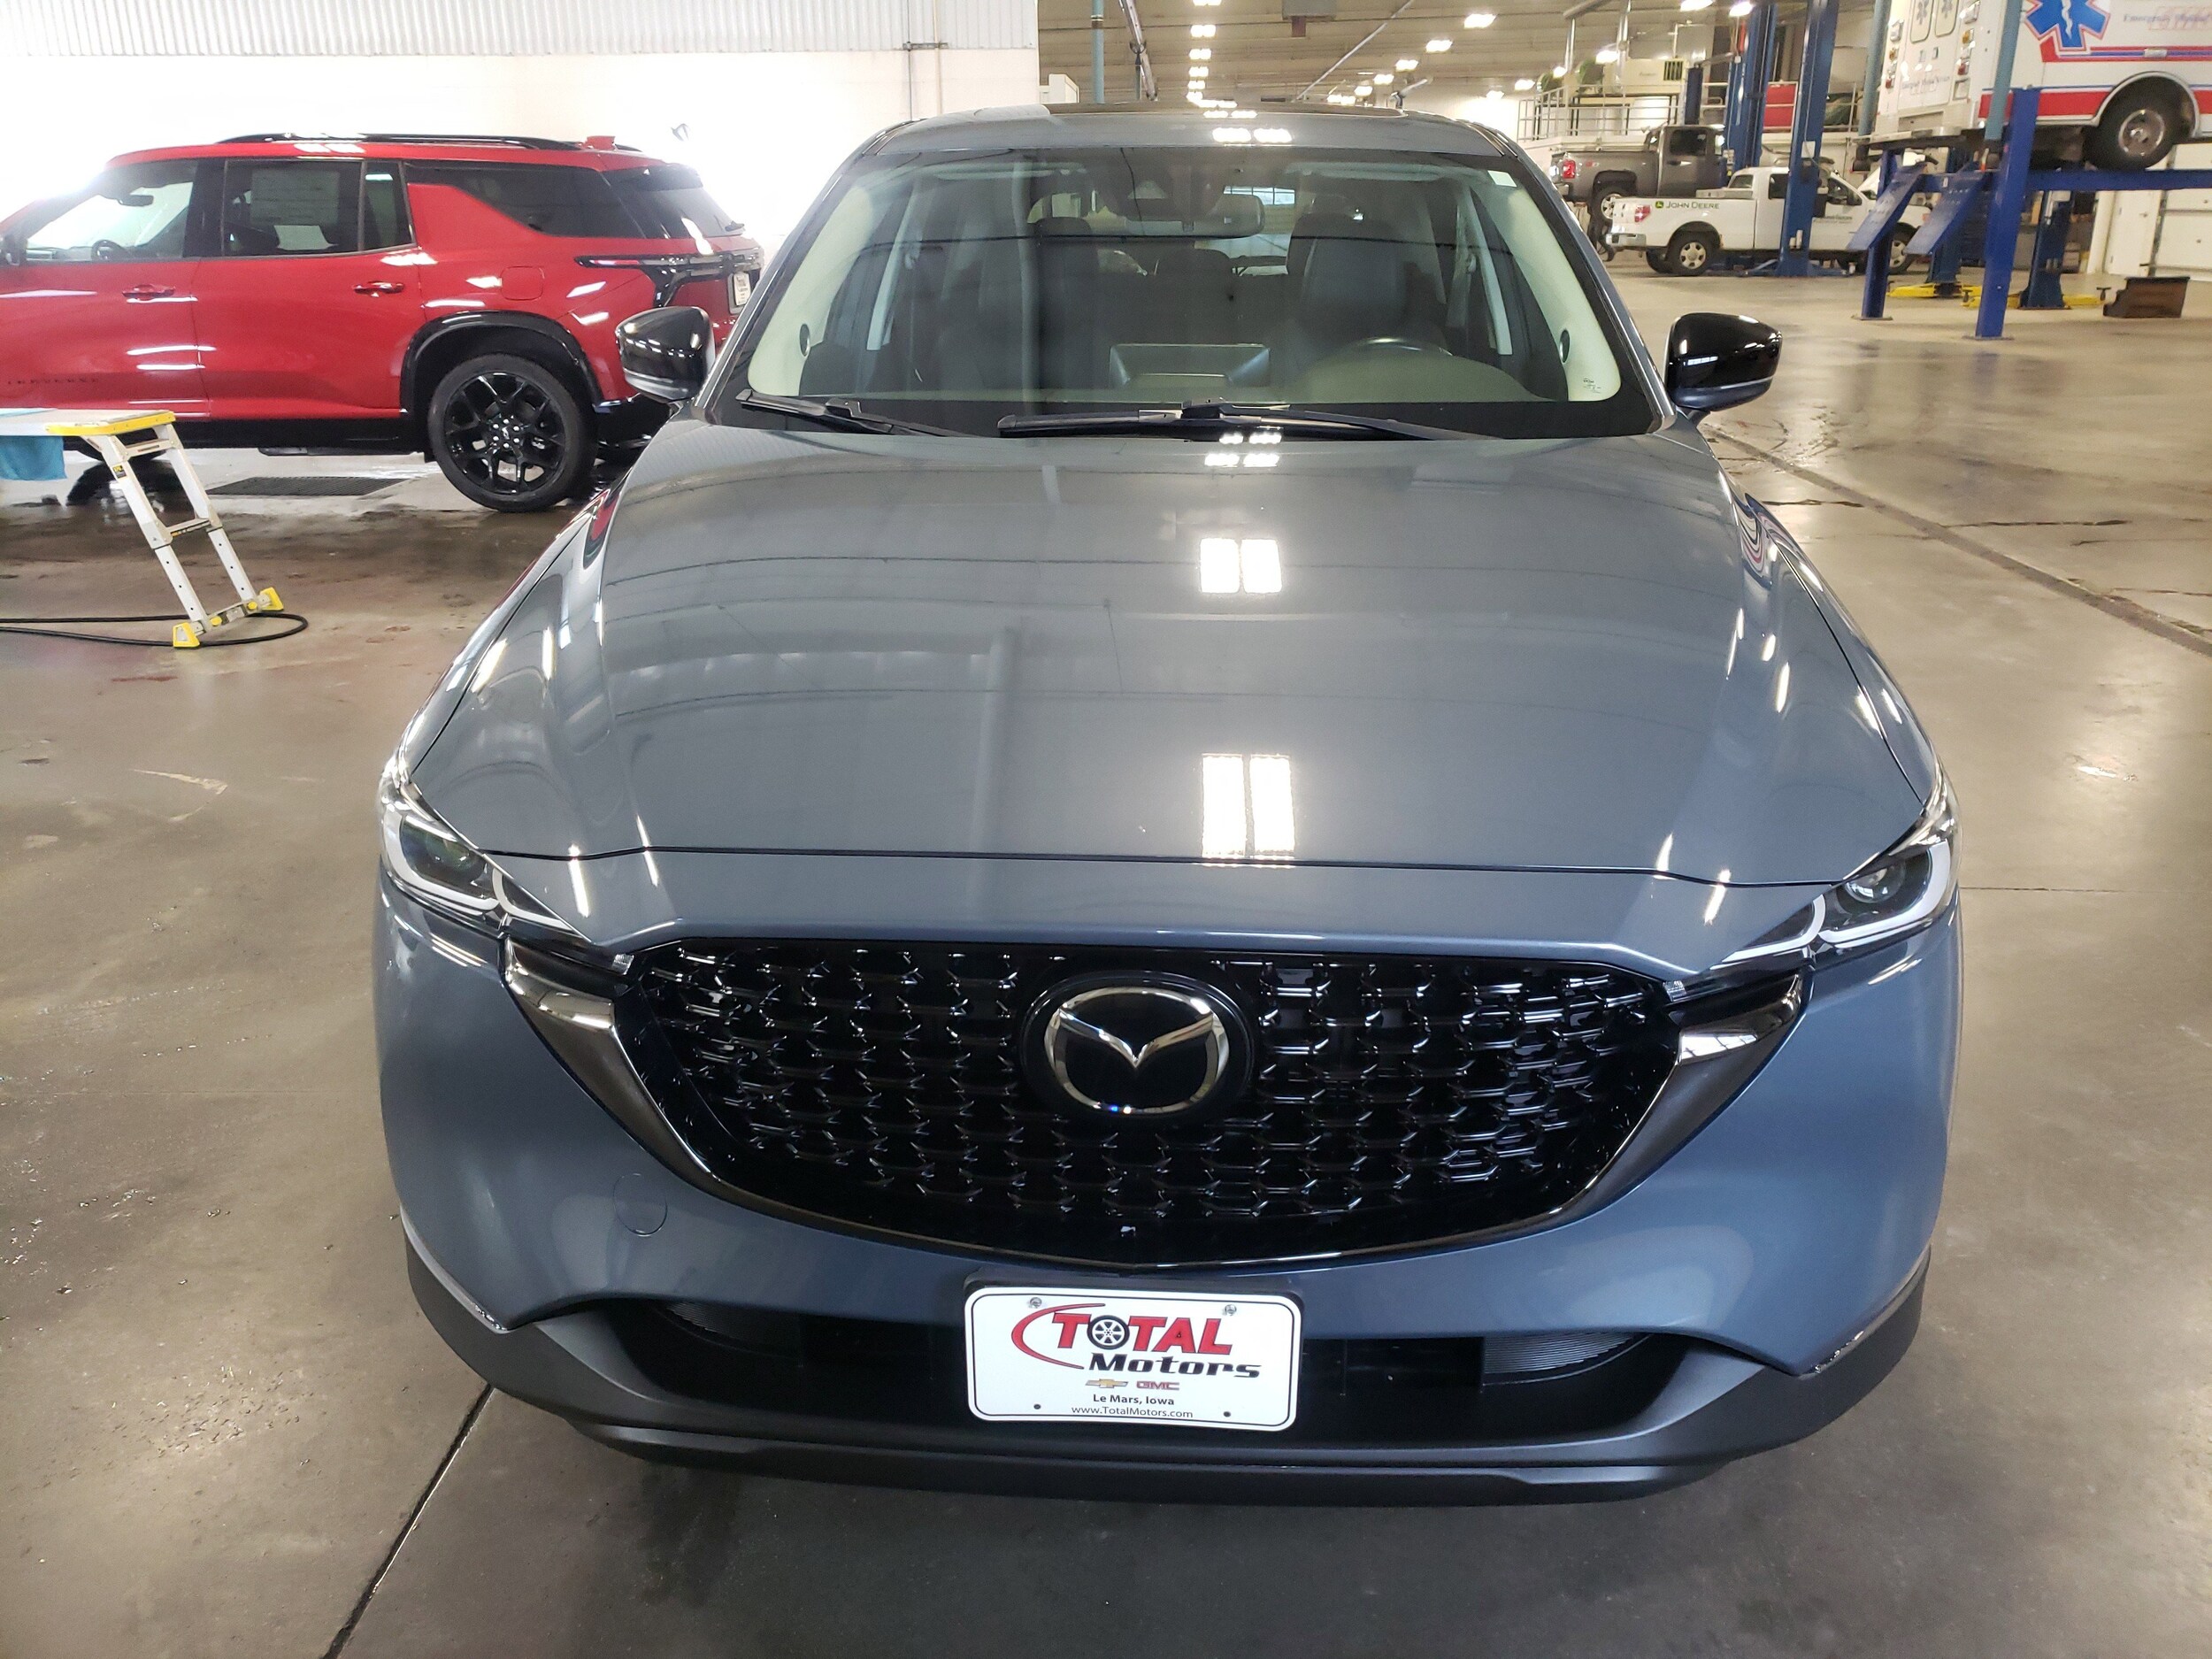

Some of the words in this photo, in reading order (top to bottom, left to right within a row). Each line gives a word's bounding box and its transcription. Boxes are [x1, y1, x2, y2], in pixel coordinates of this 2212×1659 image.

[1692, 201, 1720, 210] DEERE
[1052, 1312, 1233, 1356] TOTAL
[1088, 1352, 1262, 1379] Motors
[1136, 1380, 1180, 1391] GMC
[1093, 1394, 1107, 1403] Le
[1110, 1394, 1143, 1405] Mars,
[1146, 1396, 1175, 1406] Iowa
[1071, 1406, 1194, 1418] www.TotalMotors.com
